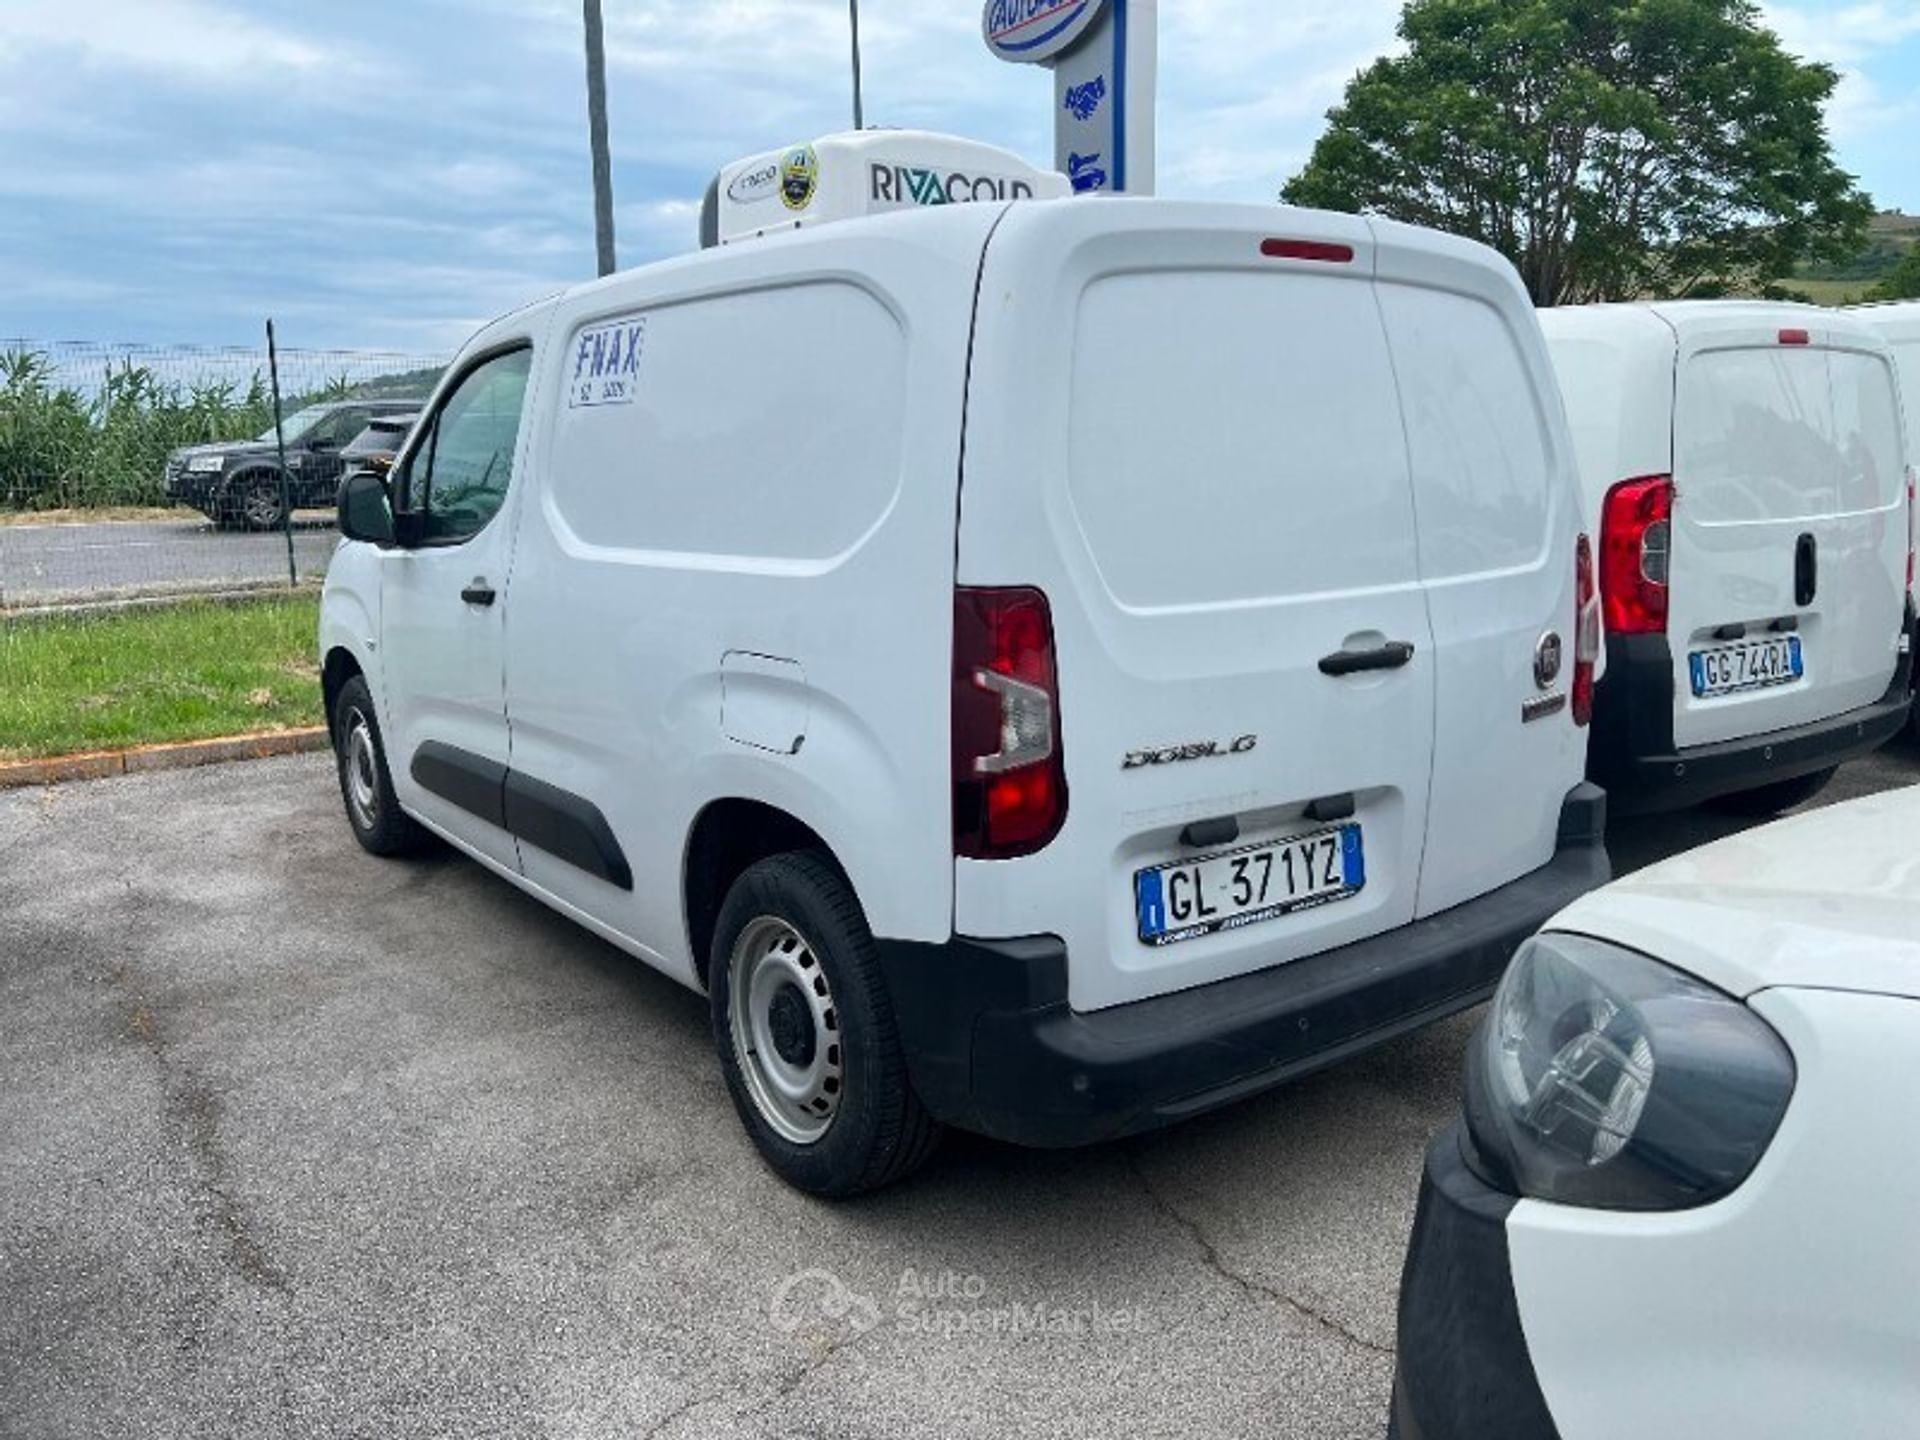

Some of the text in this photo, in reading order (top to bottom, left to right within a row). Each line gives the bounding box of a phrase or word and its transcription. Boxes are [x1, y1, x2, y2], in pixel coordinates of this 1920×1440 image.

[1706, 653, 1731, 685] GG
[1735, 645, 1790, 684] 744RA
[1168, 867, 1217, 920] GL
[1230, 838, 1341, 906] 371YZ
